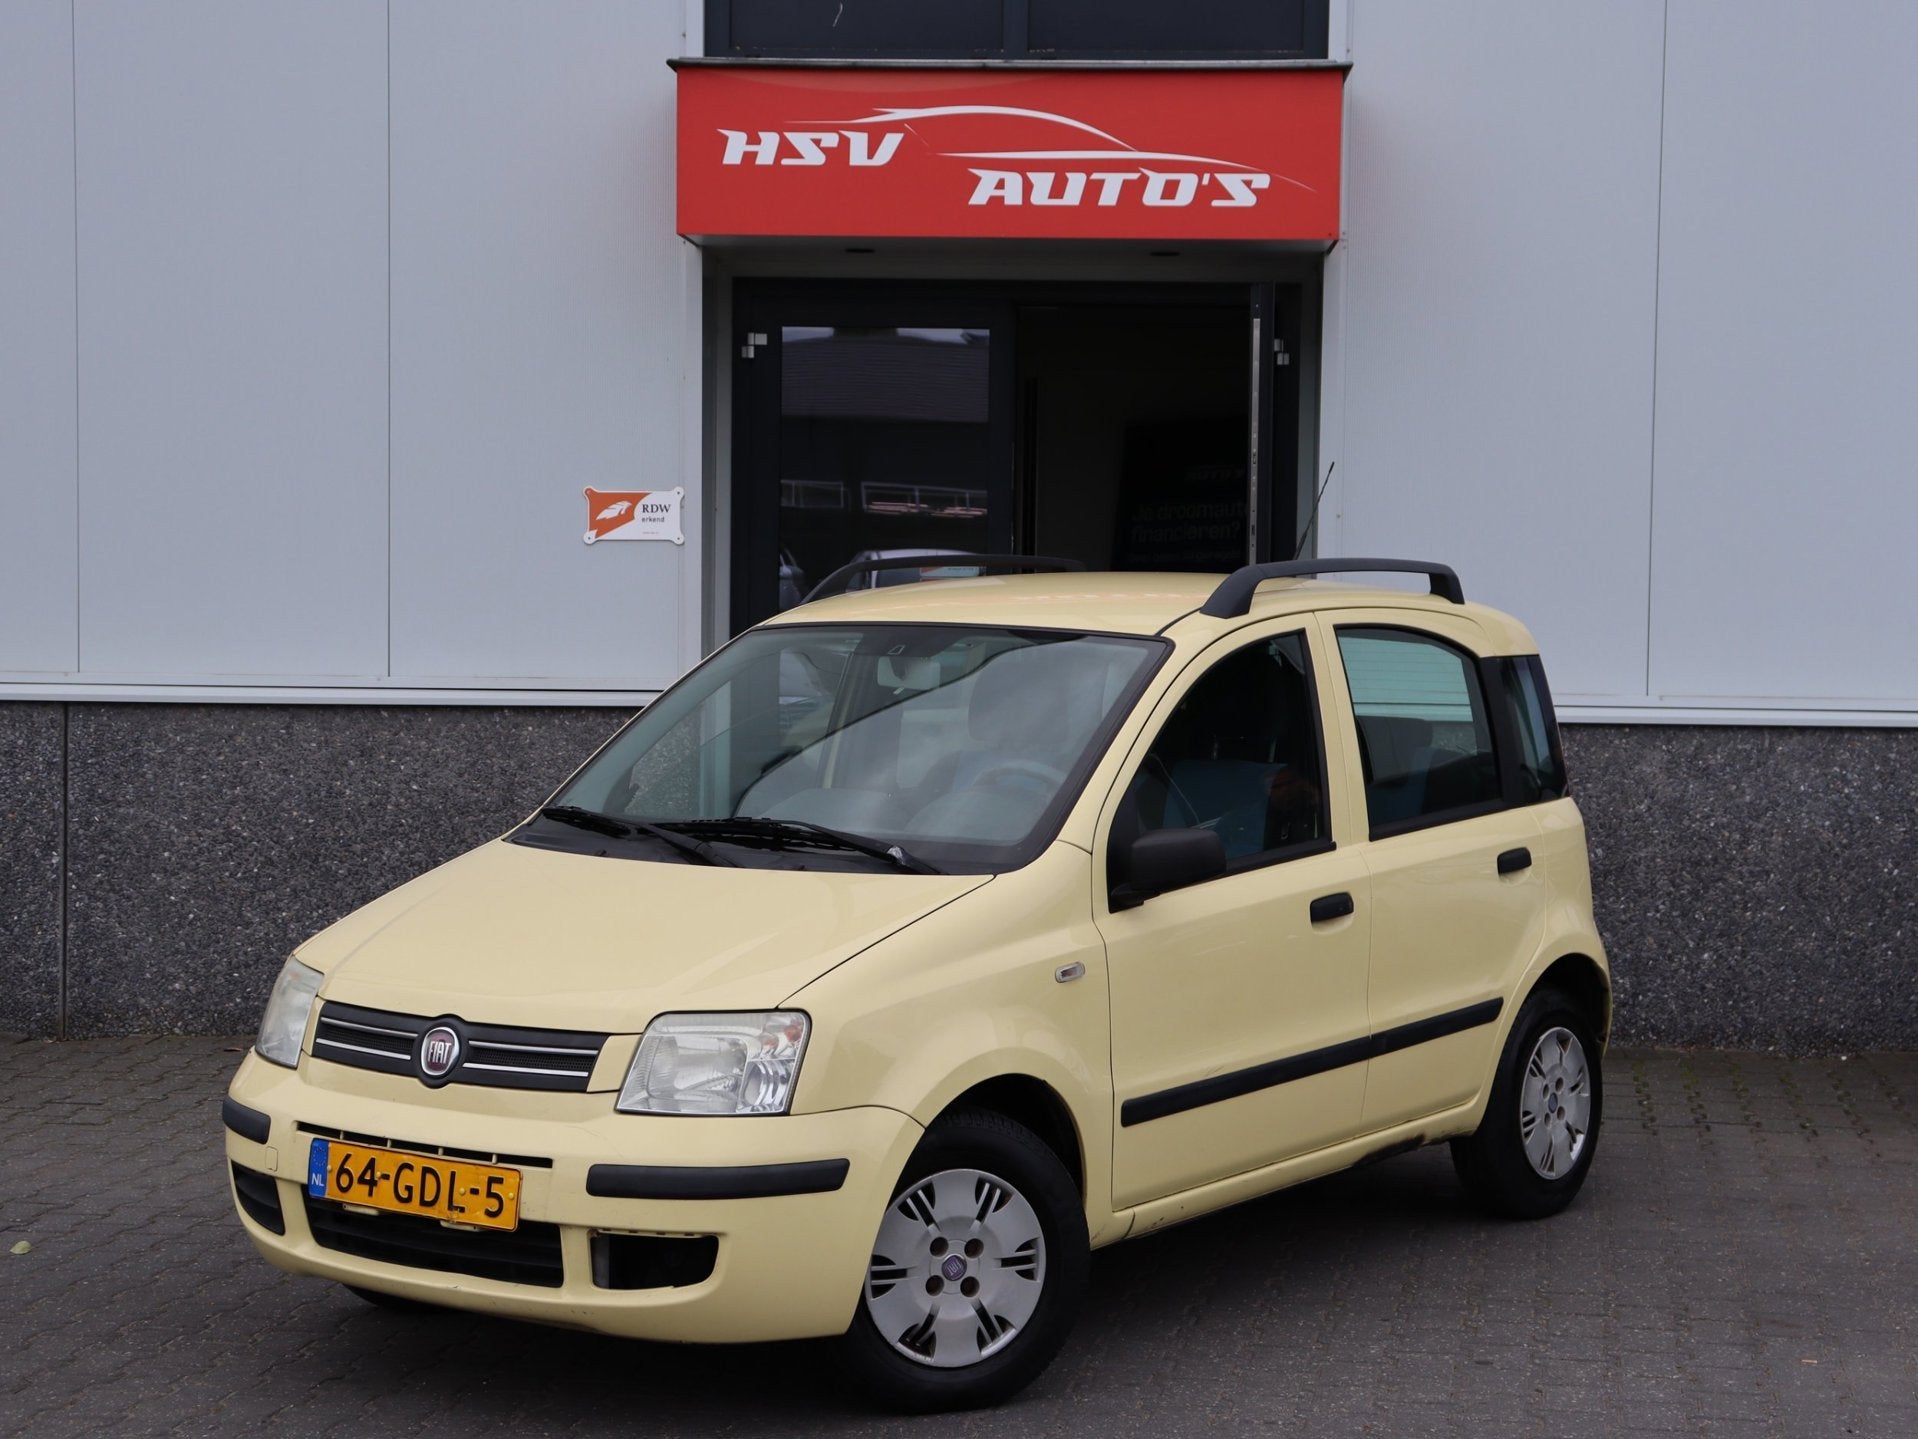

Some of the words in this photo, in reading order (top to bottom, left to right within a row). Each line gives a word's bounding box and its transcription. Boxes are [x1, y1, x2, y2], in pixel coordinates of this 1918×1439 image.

[716, 129, 905, 167] HSV
[968, 167, 1271, 207] AUTO'S
[642, 503, 671, 514] RDW
[428, 1040, 452, 1065] FIAT
[311, 1175, 325, 1187] NL
[335, 1153, 505, 1219] 64-GDL-5
